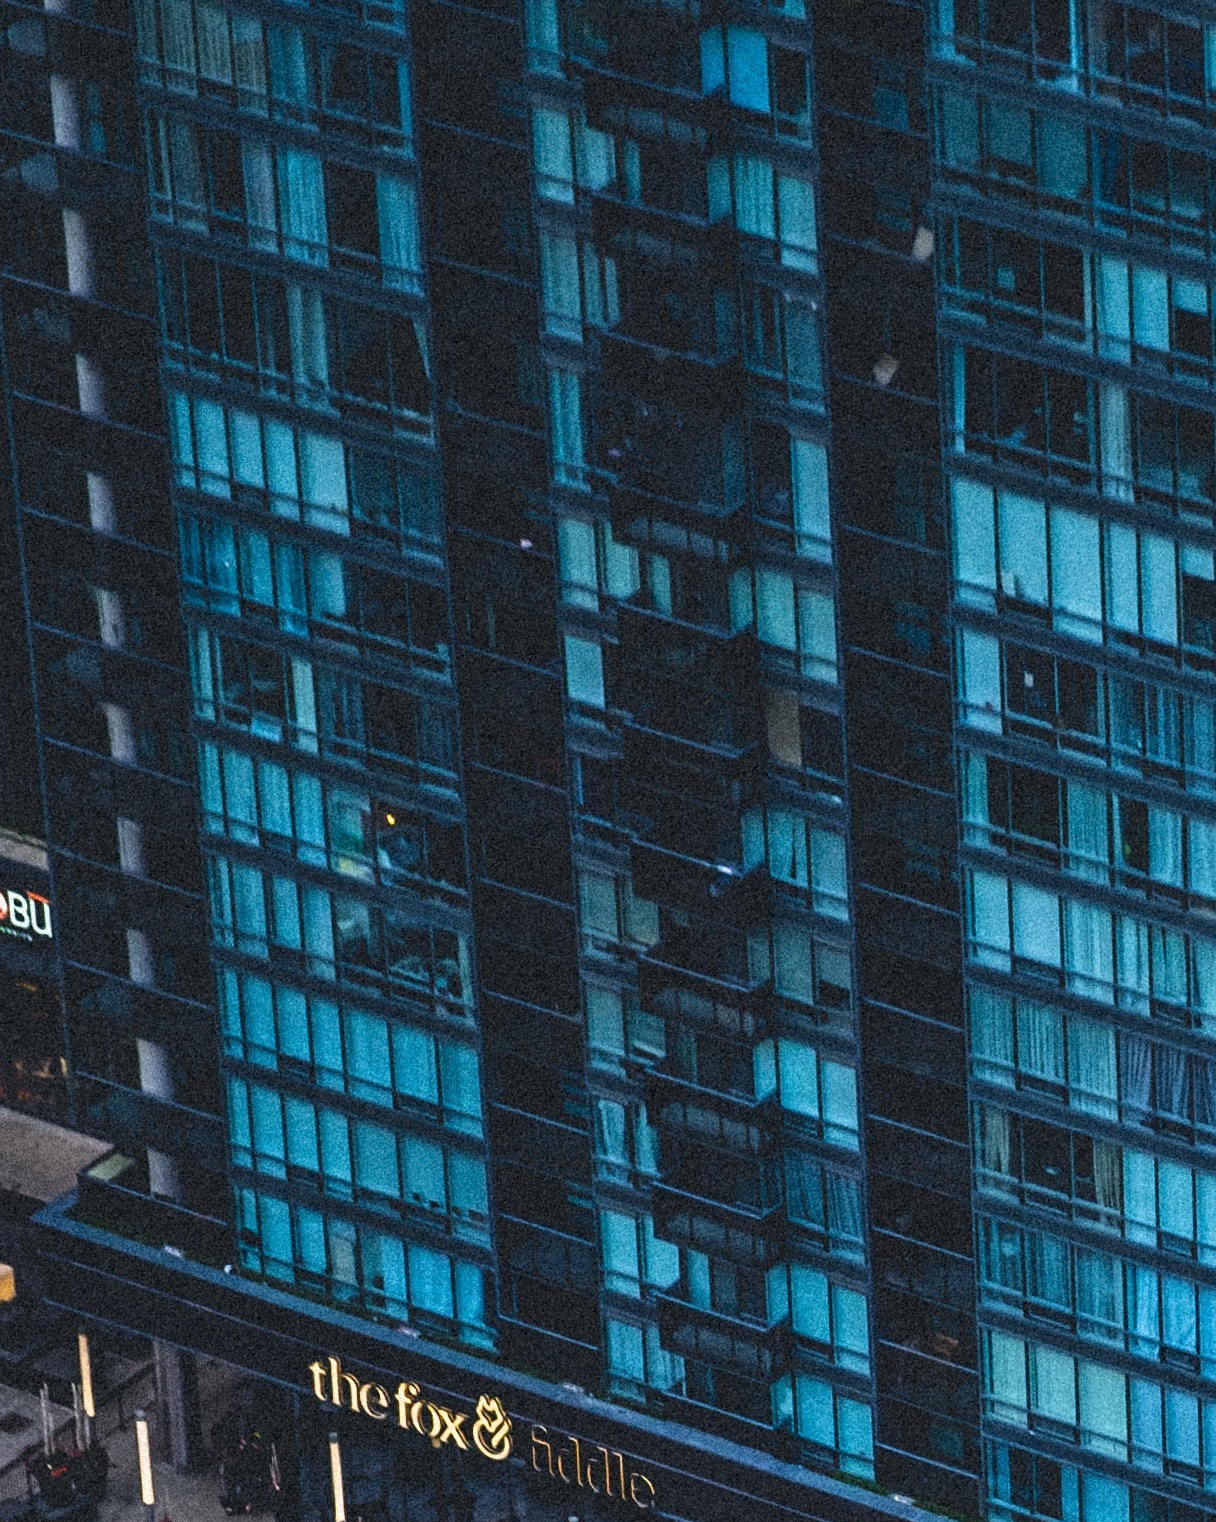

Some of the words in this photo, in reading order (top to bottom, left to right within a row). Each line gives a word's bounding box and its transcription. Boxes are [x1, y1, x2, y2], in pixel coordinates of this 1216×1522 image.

[309, 1356, 390, 1420] the
[395, 1381, 470, 1450] fox
[531, 1424, 655, 1508] fiddle
